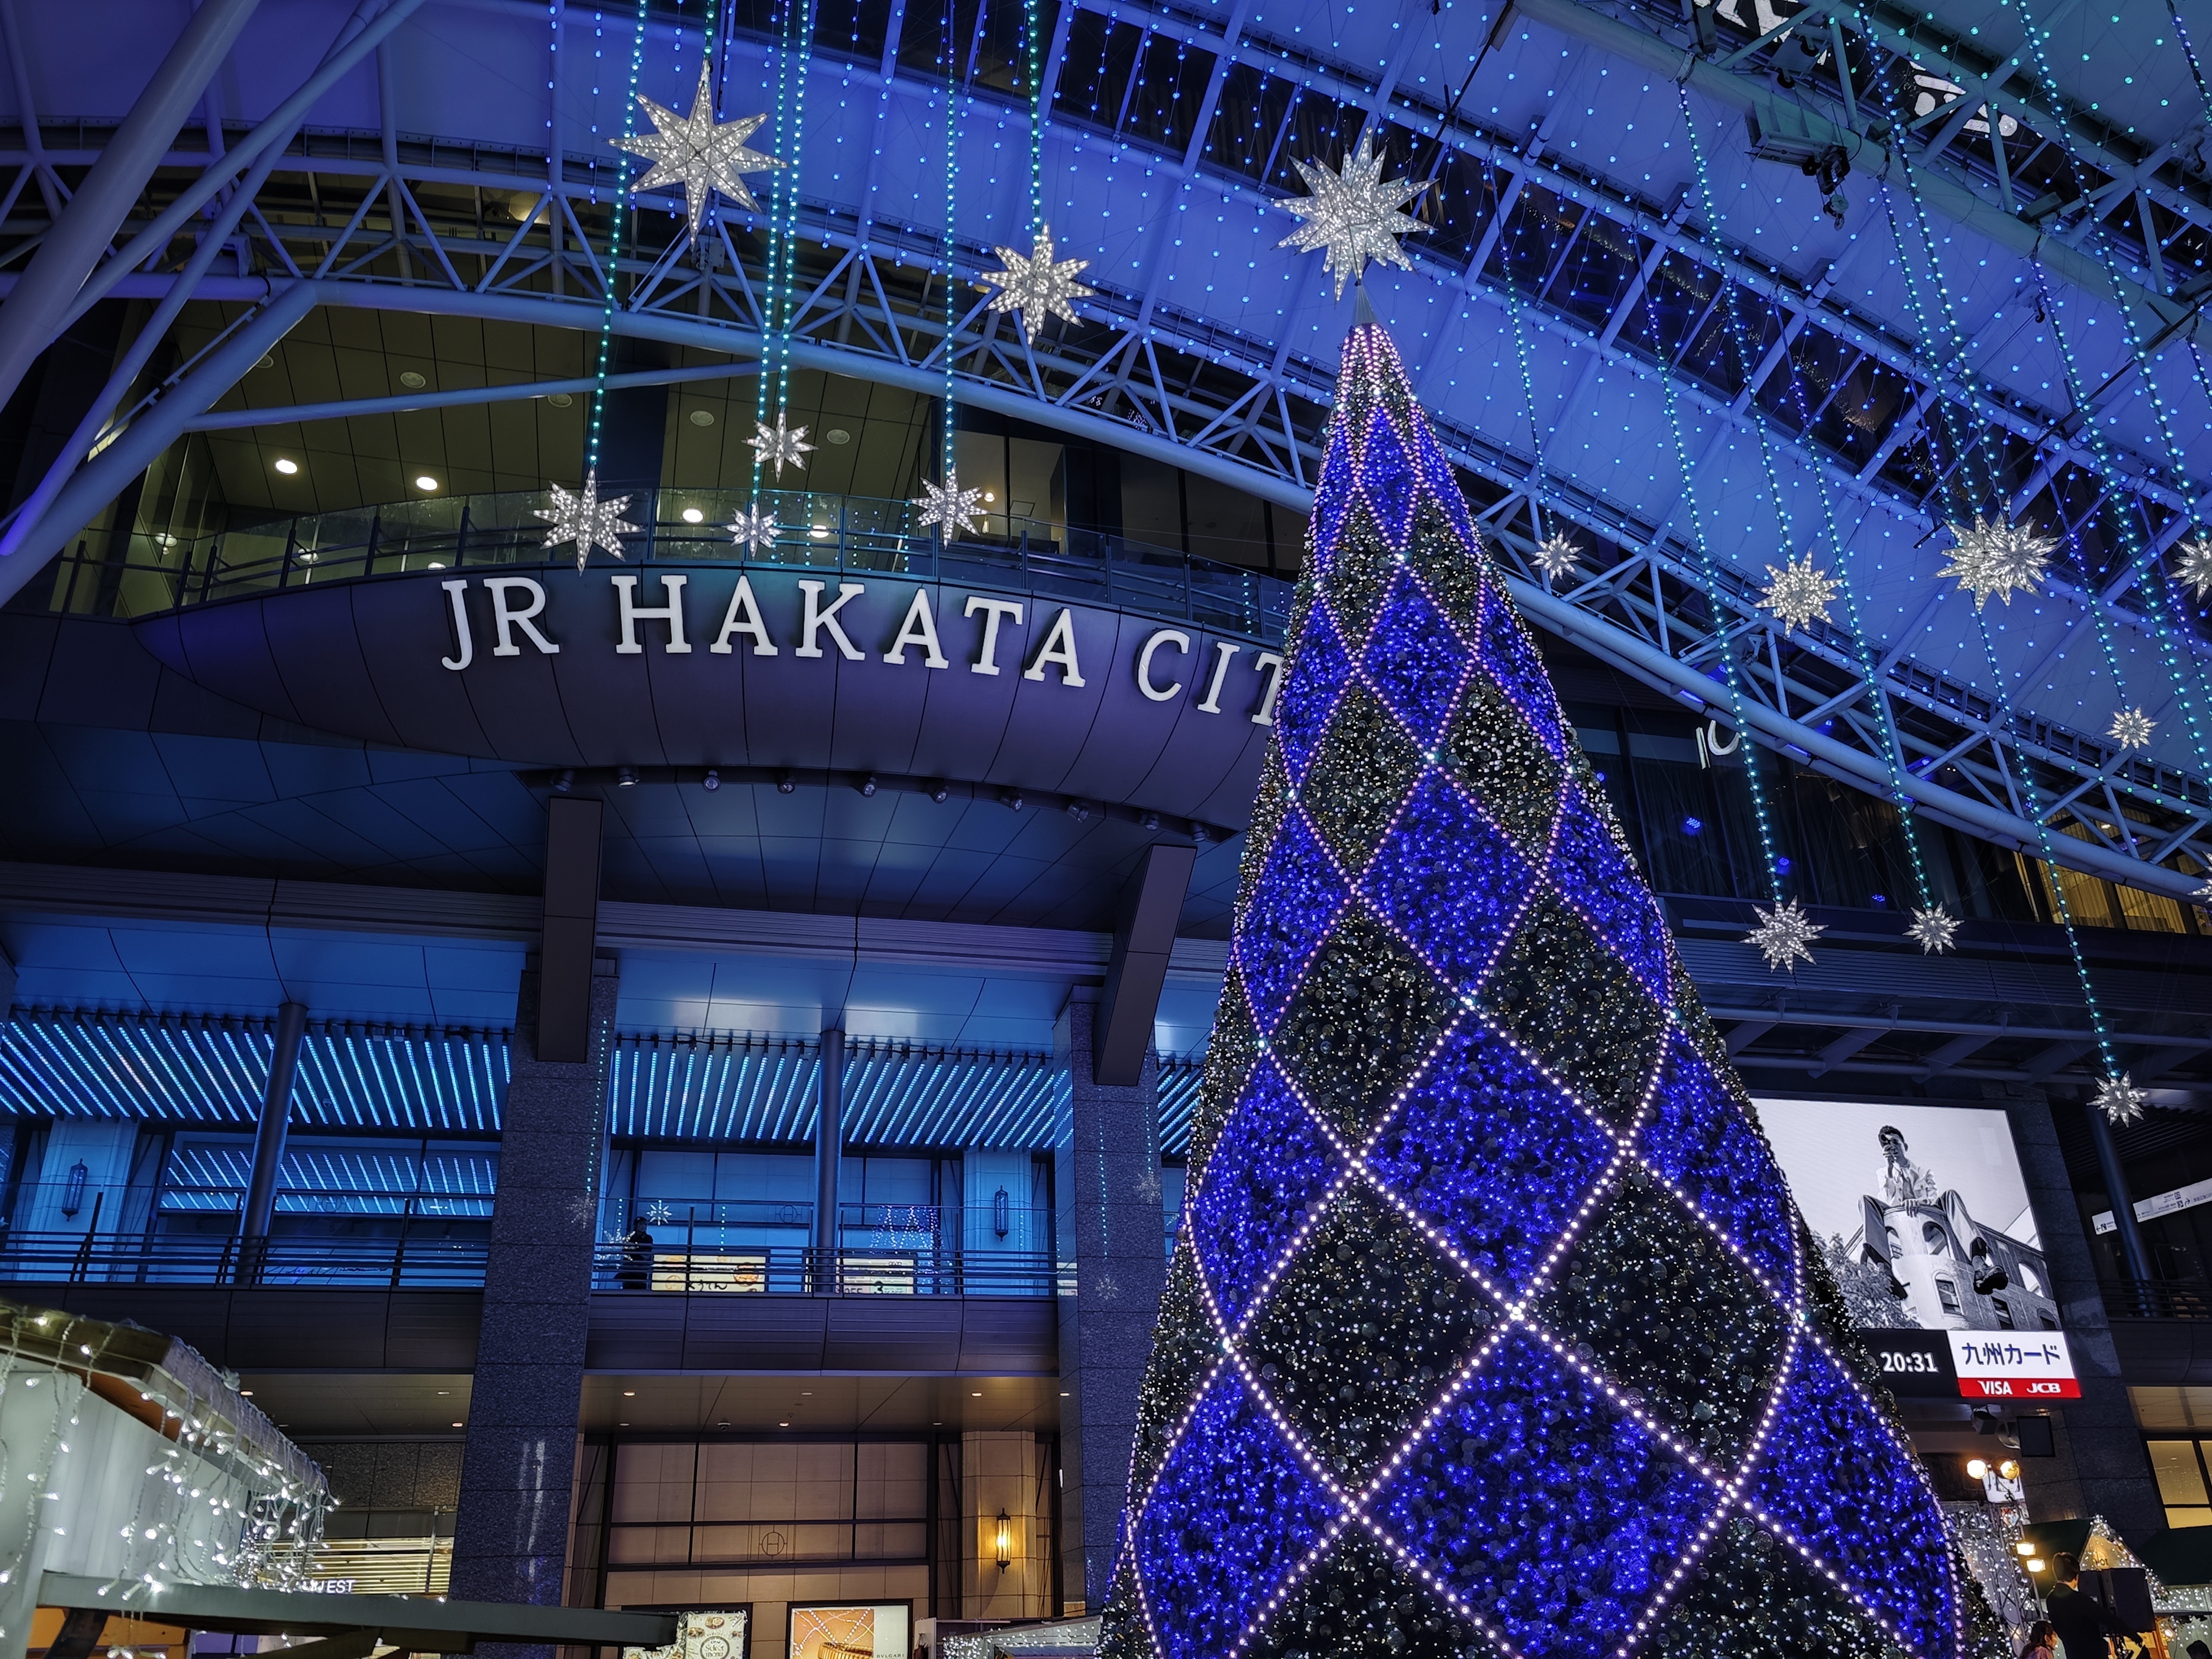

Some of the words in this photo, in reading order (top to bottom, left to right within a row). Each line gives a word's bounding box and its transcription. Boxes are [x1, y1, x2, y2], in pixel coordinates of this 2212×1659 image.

[441, 576, 561, 671] JR
[610, 574, 1086, 688] HAKATA
[1880, 1351, 1938, 1373] 20:31
[1961, 1343, 2060, 1365] 九州カード
[1977, 1380, 2013, 1395] VISA
[2026, 1382, 2061, 1393] JCB
